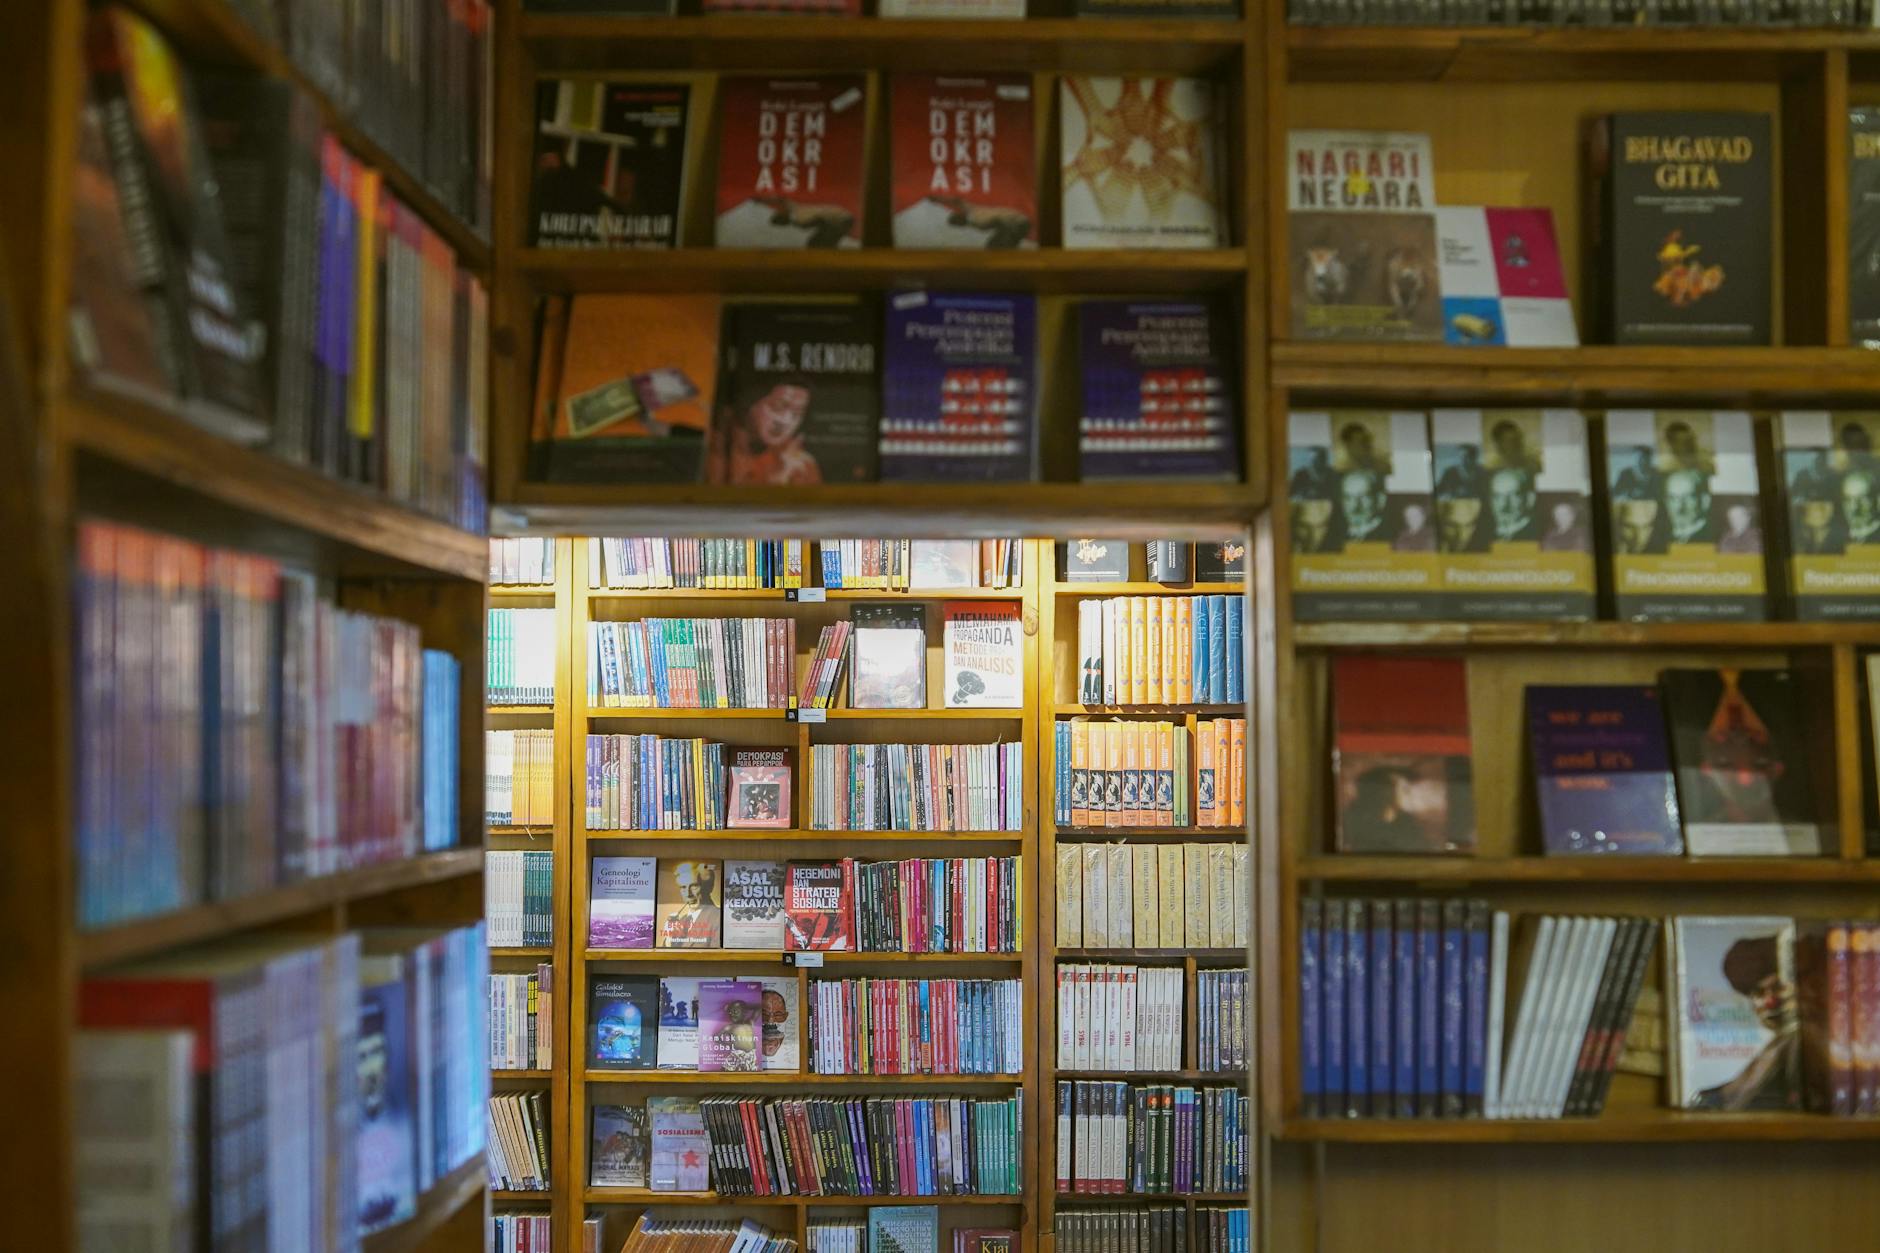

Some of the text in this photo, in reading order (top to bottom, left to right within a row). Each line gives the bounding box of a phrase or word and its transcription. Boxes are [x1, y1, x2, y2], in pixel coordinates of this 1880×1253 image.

[1625, 136, 1752, 163] BHAGAVAD
[1296, 148, 1420, 177] NAGARI
[1654, 163, 1720, 190] GITA
[954, 613, 1013, 628] MEMAHAMI
[953, 627, 1014, 646] PROPAGANDA
[967, 656, 1014, 675] ANALISIS
[737, 752, 784, 760] DEMOKRASI
[601, 868, 641, 878] Geneologi
[729, 872, 771, 885] ASAL
[793, 868, 840, 879] HEGEMONI
[597, 877, 649, 887] Kapitalisme
[793, 879, 809, 888] DAN
[742, 886, 783, 898] USUL
[793, 887, 840, 898] STRATEGI
[726, 899, 784, 908] KEKAYAAN
[793, 898, 838, 909] SOSIALIS
